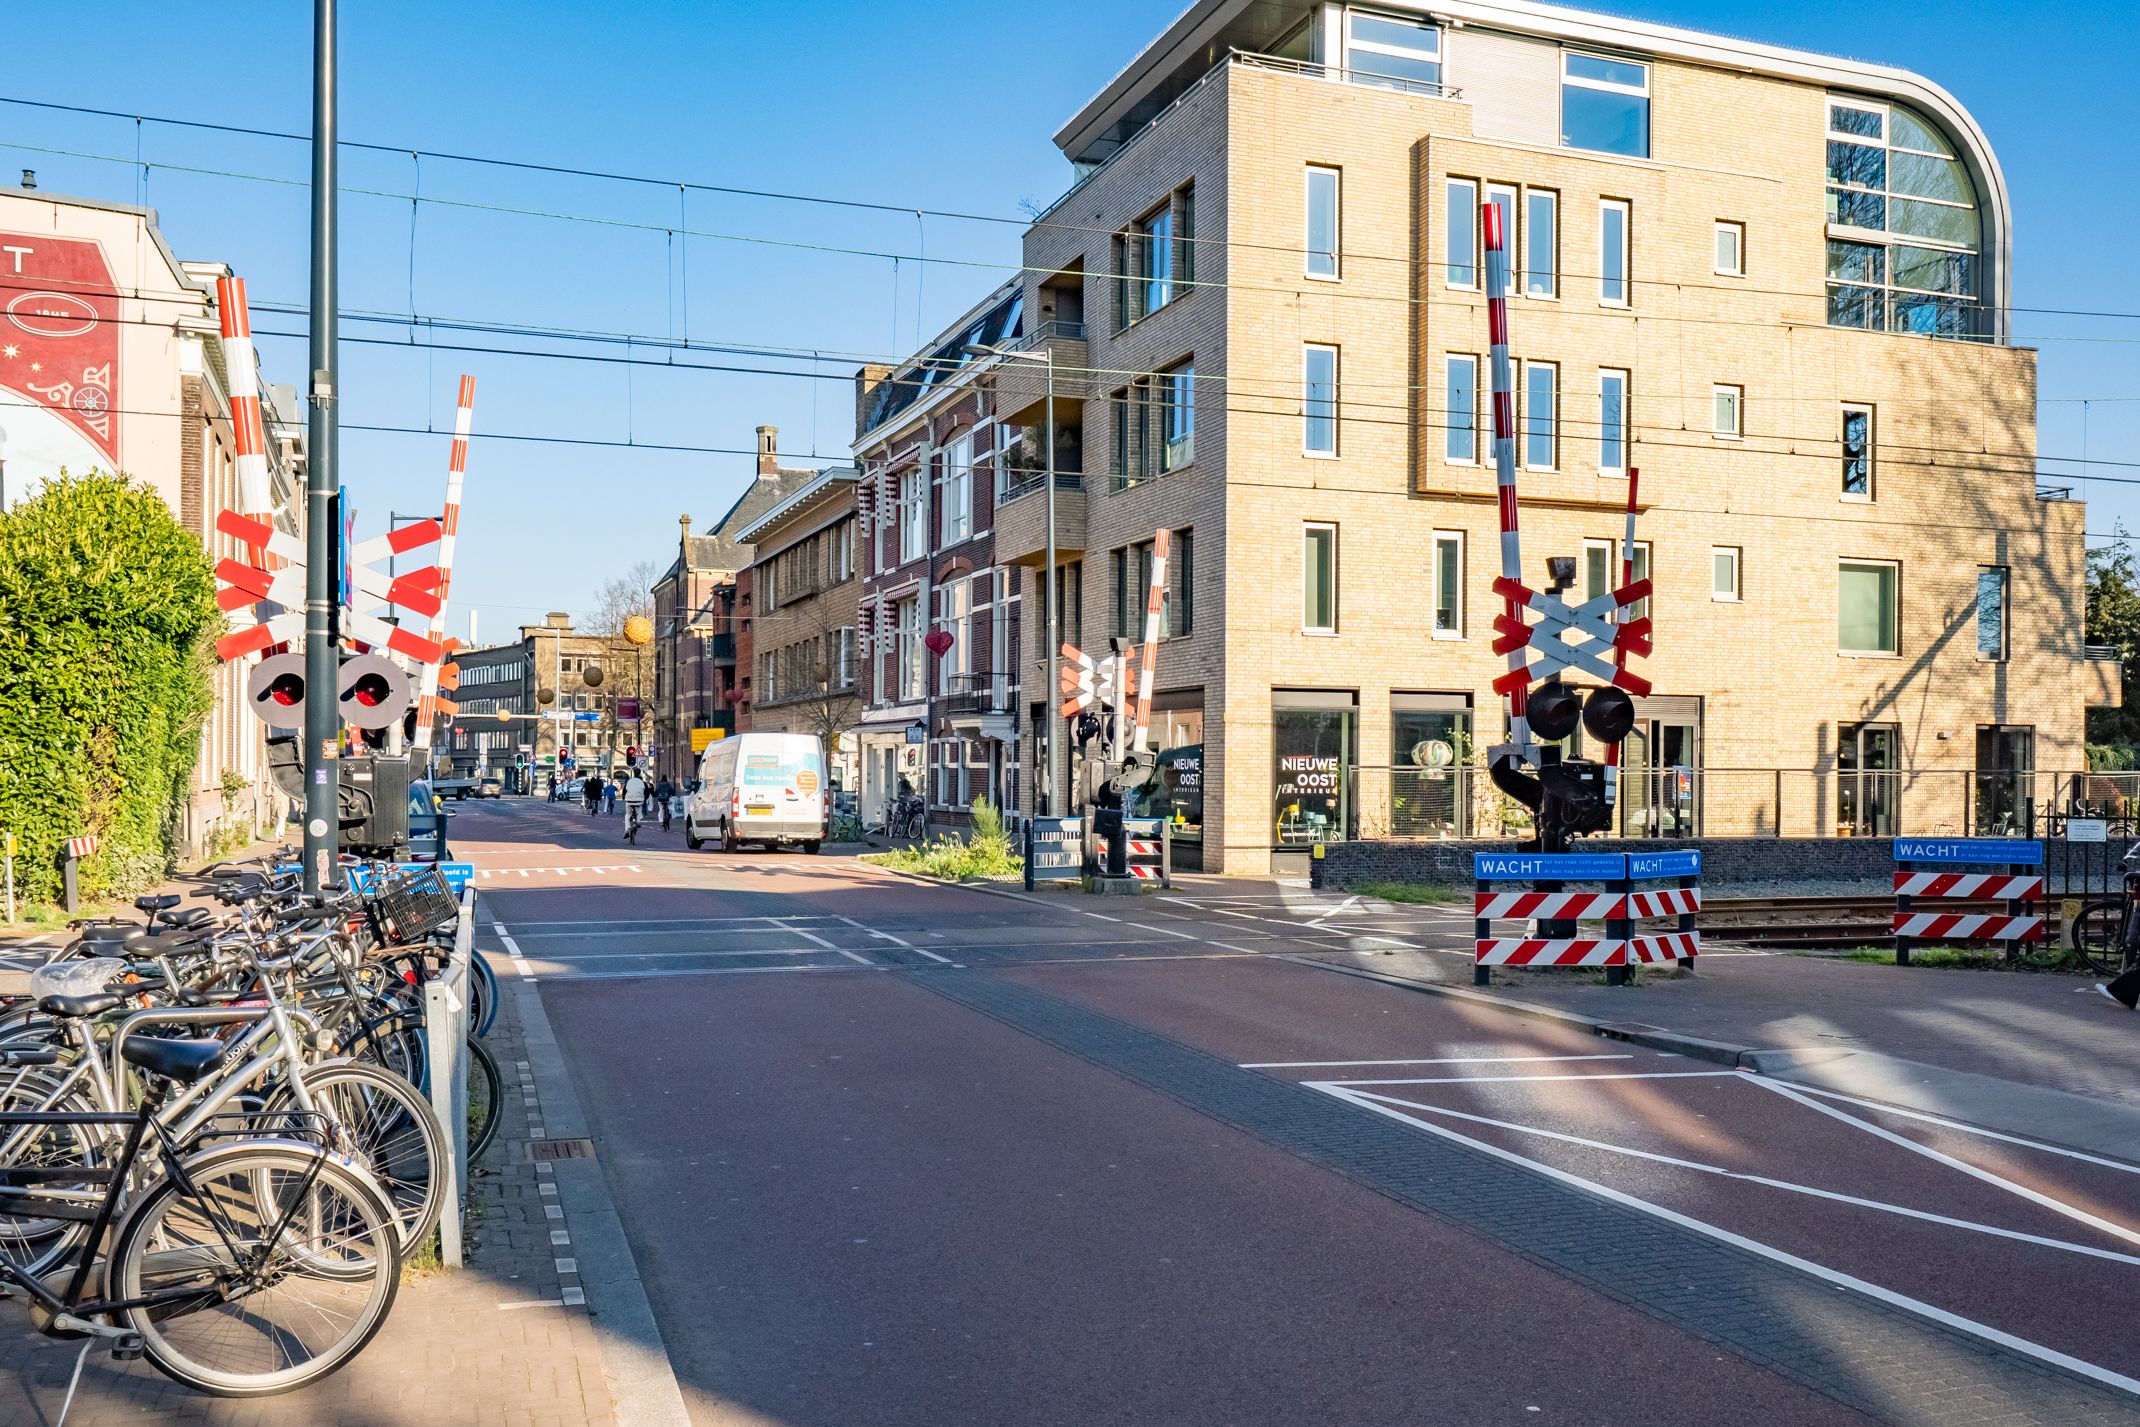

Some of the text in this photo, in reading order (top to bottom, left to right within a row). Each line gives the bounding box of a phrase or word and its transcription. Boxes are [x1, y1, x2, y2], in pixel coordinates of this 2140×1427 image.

[1173, 758, 1200, 770] NIEUWE
[1281, 757, 1337, 771] NIEUWE
[1180, 773, 1200, 785] OOST
[1297, 773, 1336, 786] OOST
[1900, 844, 1959, 857] WACHT
[1481, 860, 1543, 873] WACHT
[1632, 859, 1663, 872] WACHT
